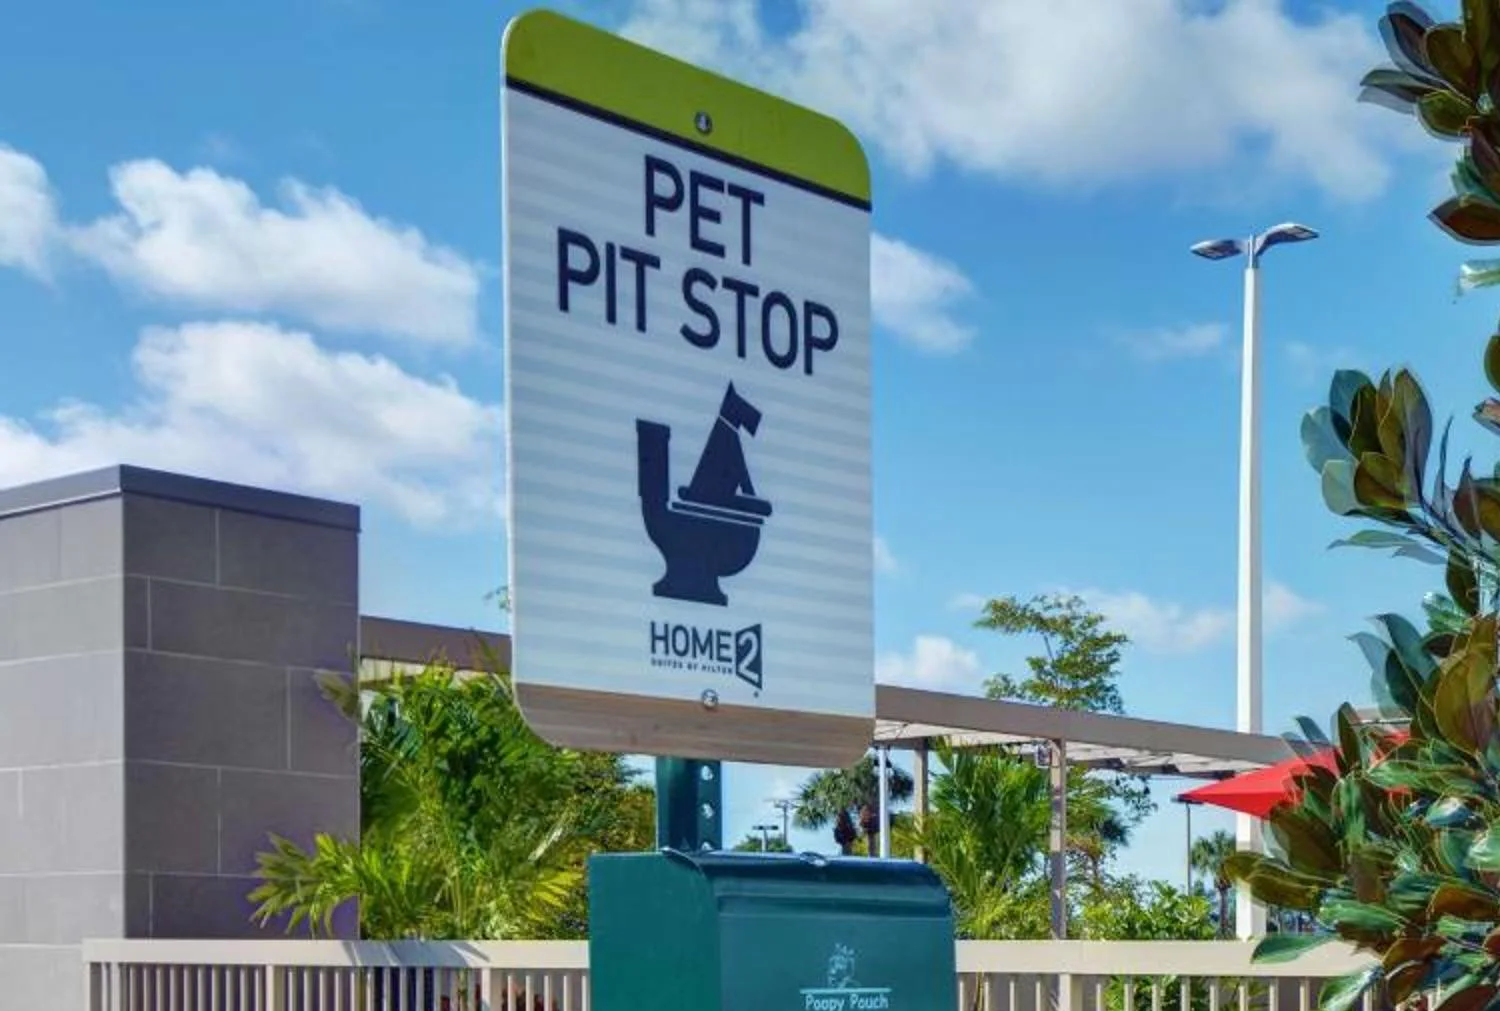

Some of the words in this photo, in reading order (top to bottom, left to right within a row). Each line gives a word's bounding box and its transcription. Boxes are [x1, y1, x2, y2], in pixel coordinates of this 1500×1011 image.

[644, 154, 765, 266] PET
[557, 226, 661, 333] PIT
[679, 266, 839, 375] STOP
[850, 993, 889, 1010] Pouch
